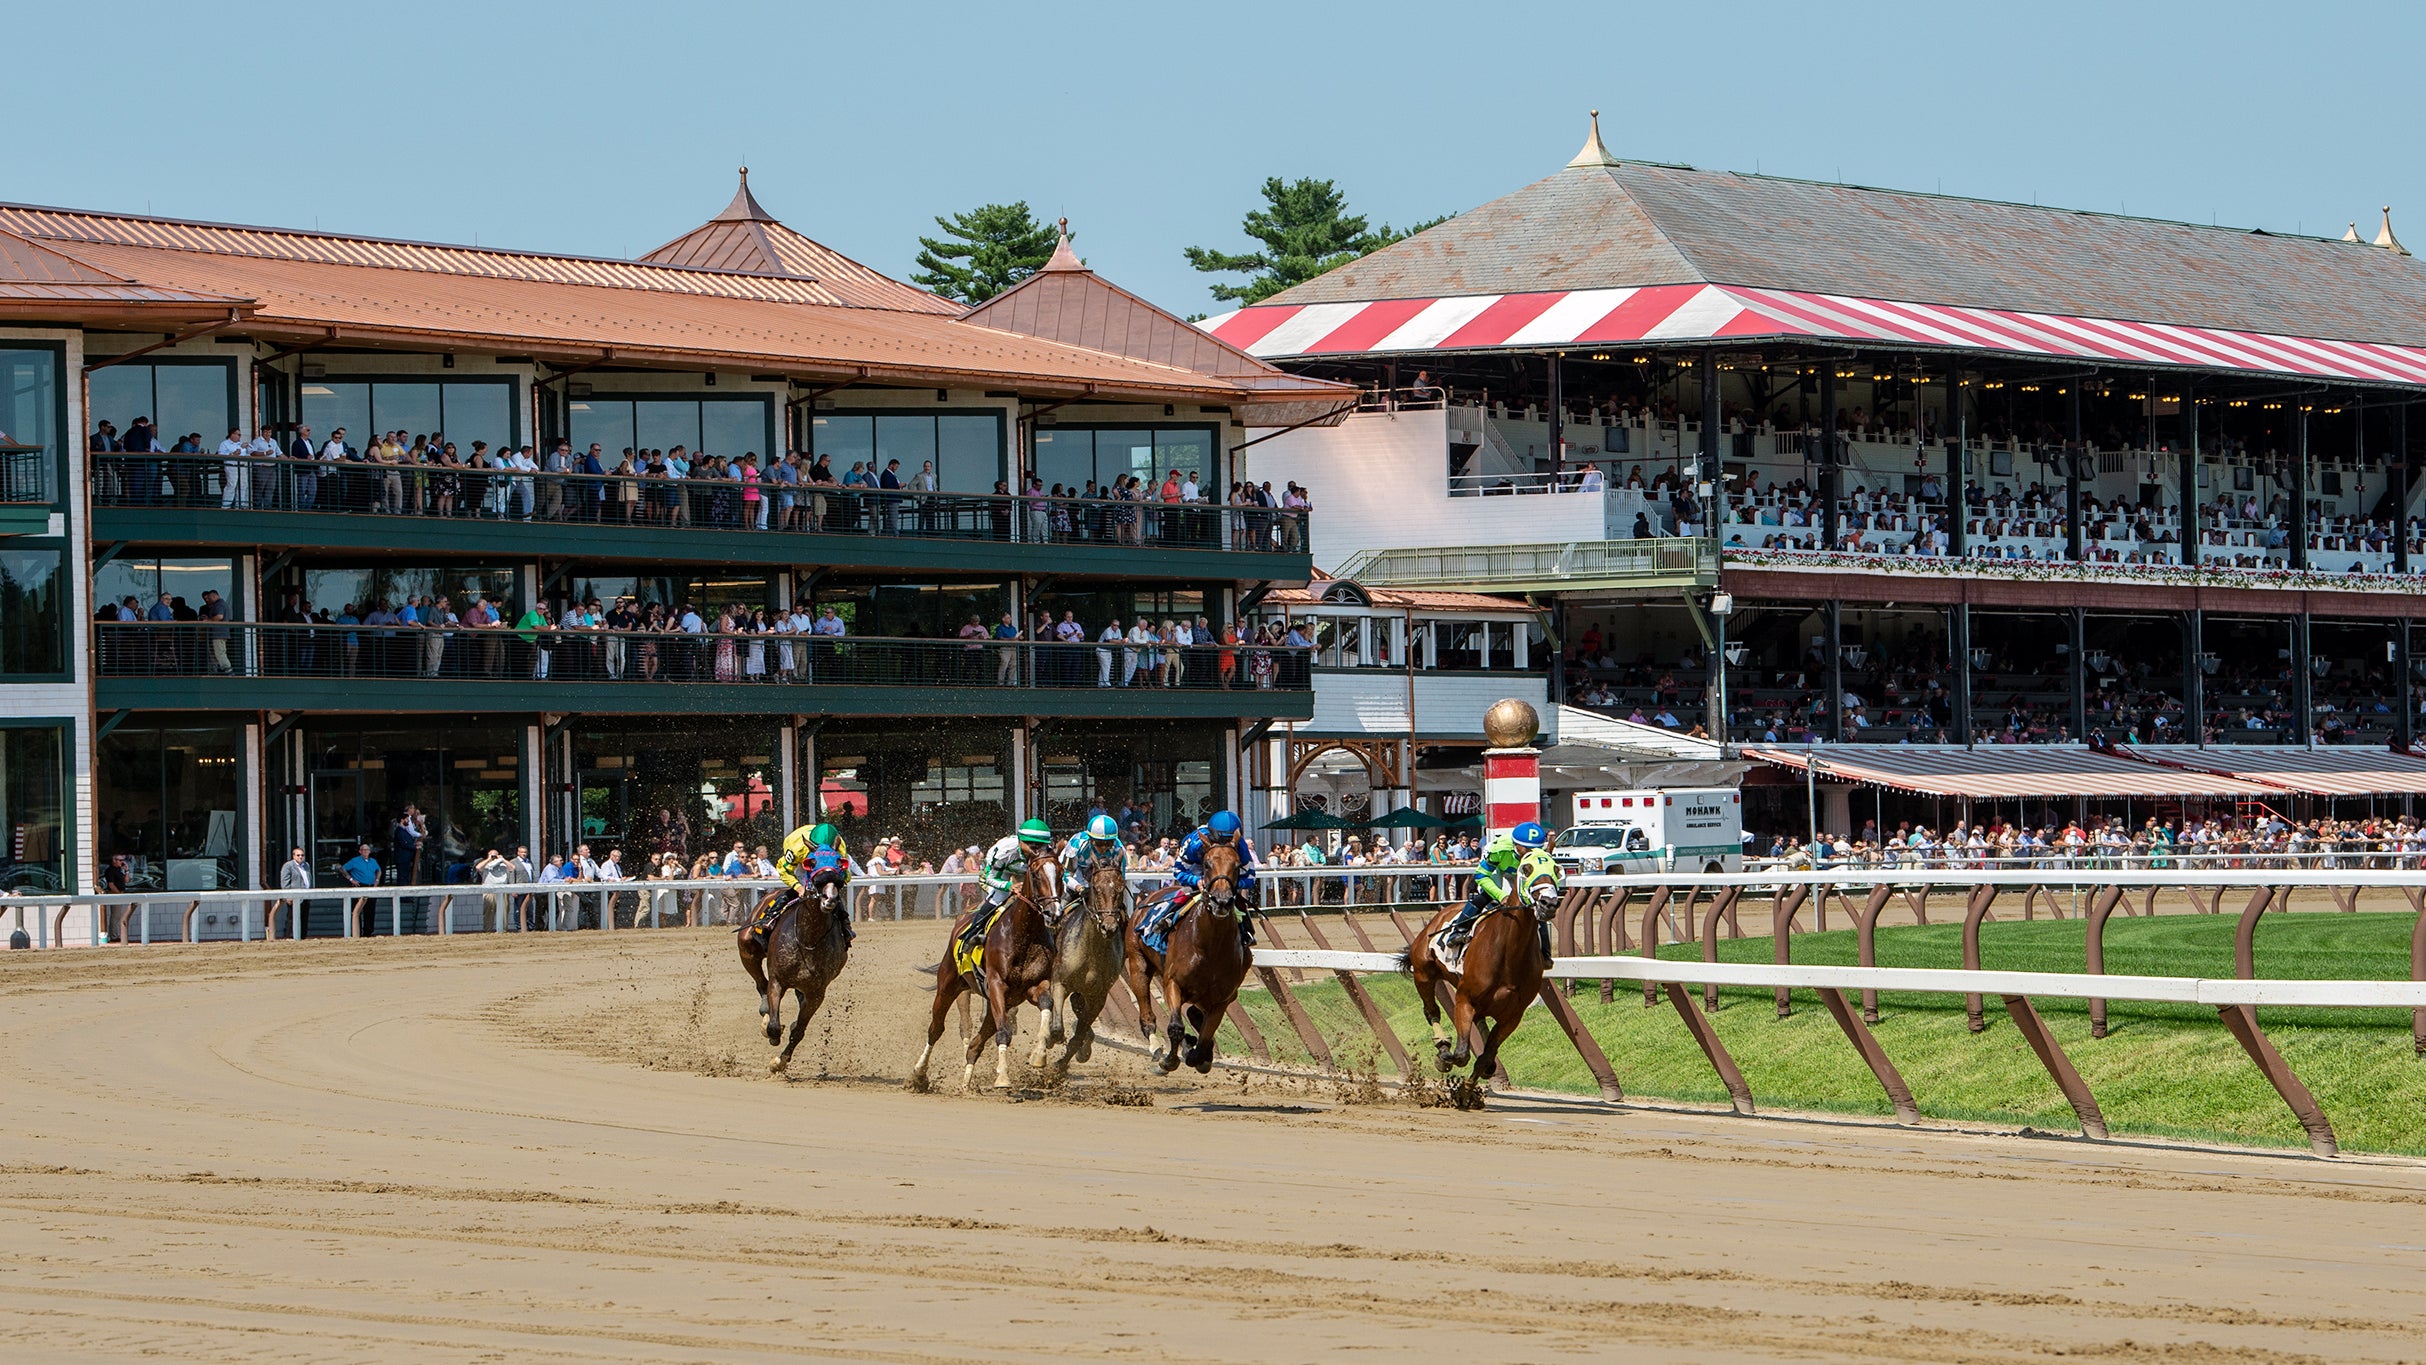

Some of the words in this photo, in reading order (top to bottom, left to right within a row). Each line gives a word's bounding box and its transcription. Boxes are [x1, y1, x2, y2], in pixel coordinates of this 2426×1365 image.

[1686, 806, 1721, 816] MOHAWK
[1528, 828, 1539, 841] P
[785, 850, 794, 864] 6
[1537, 856, 1548, 865] P
